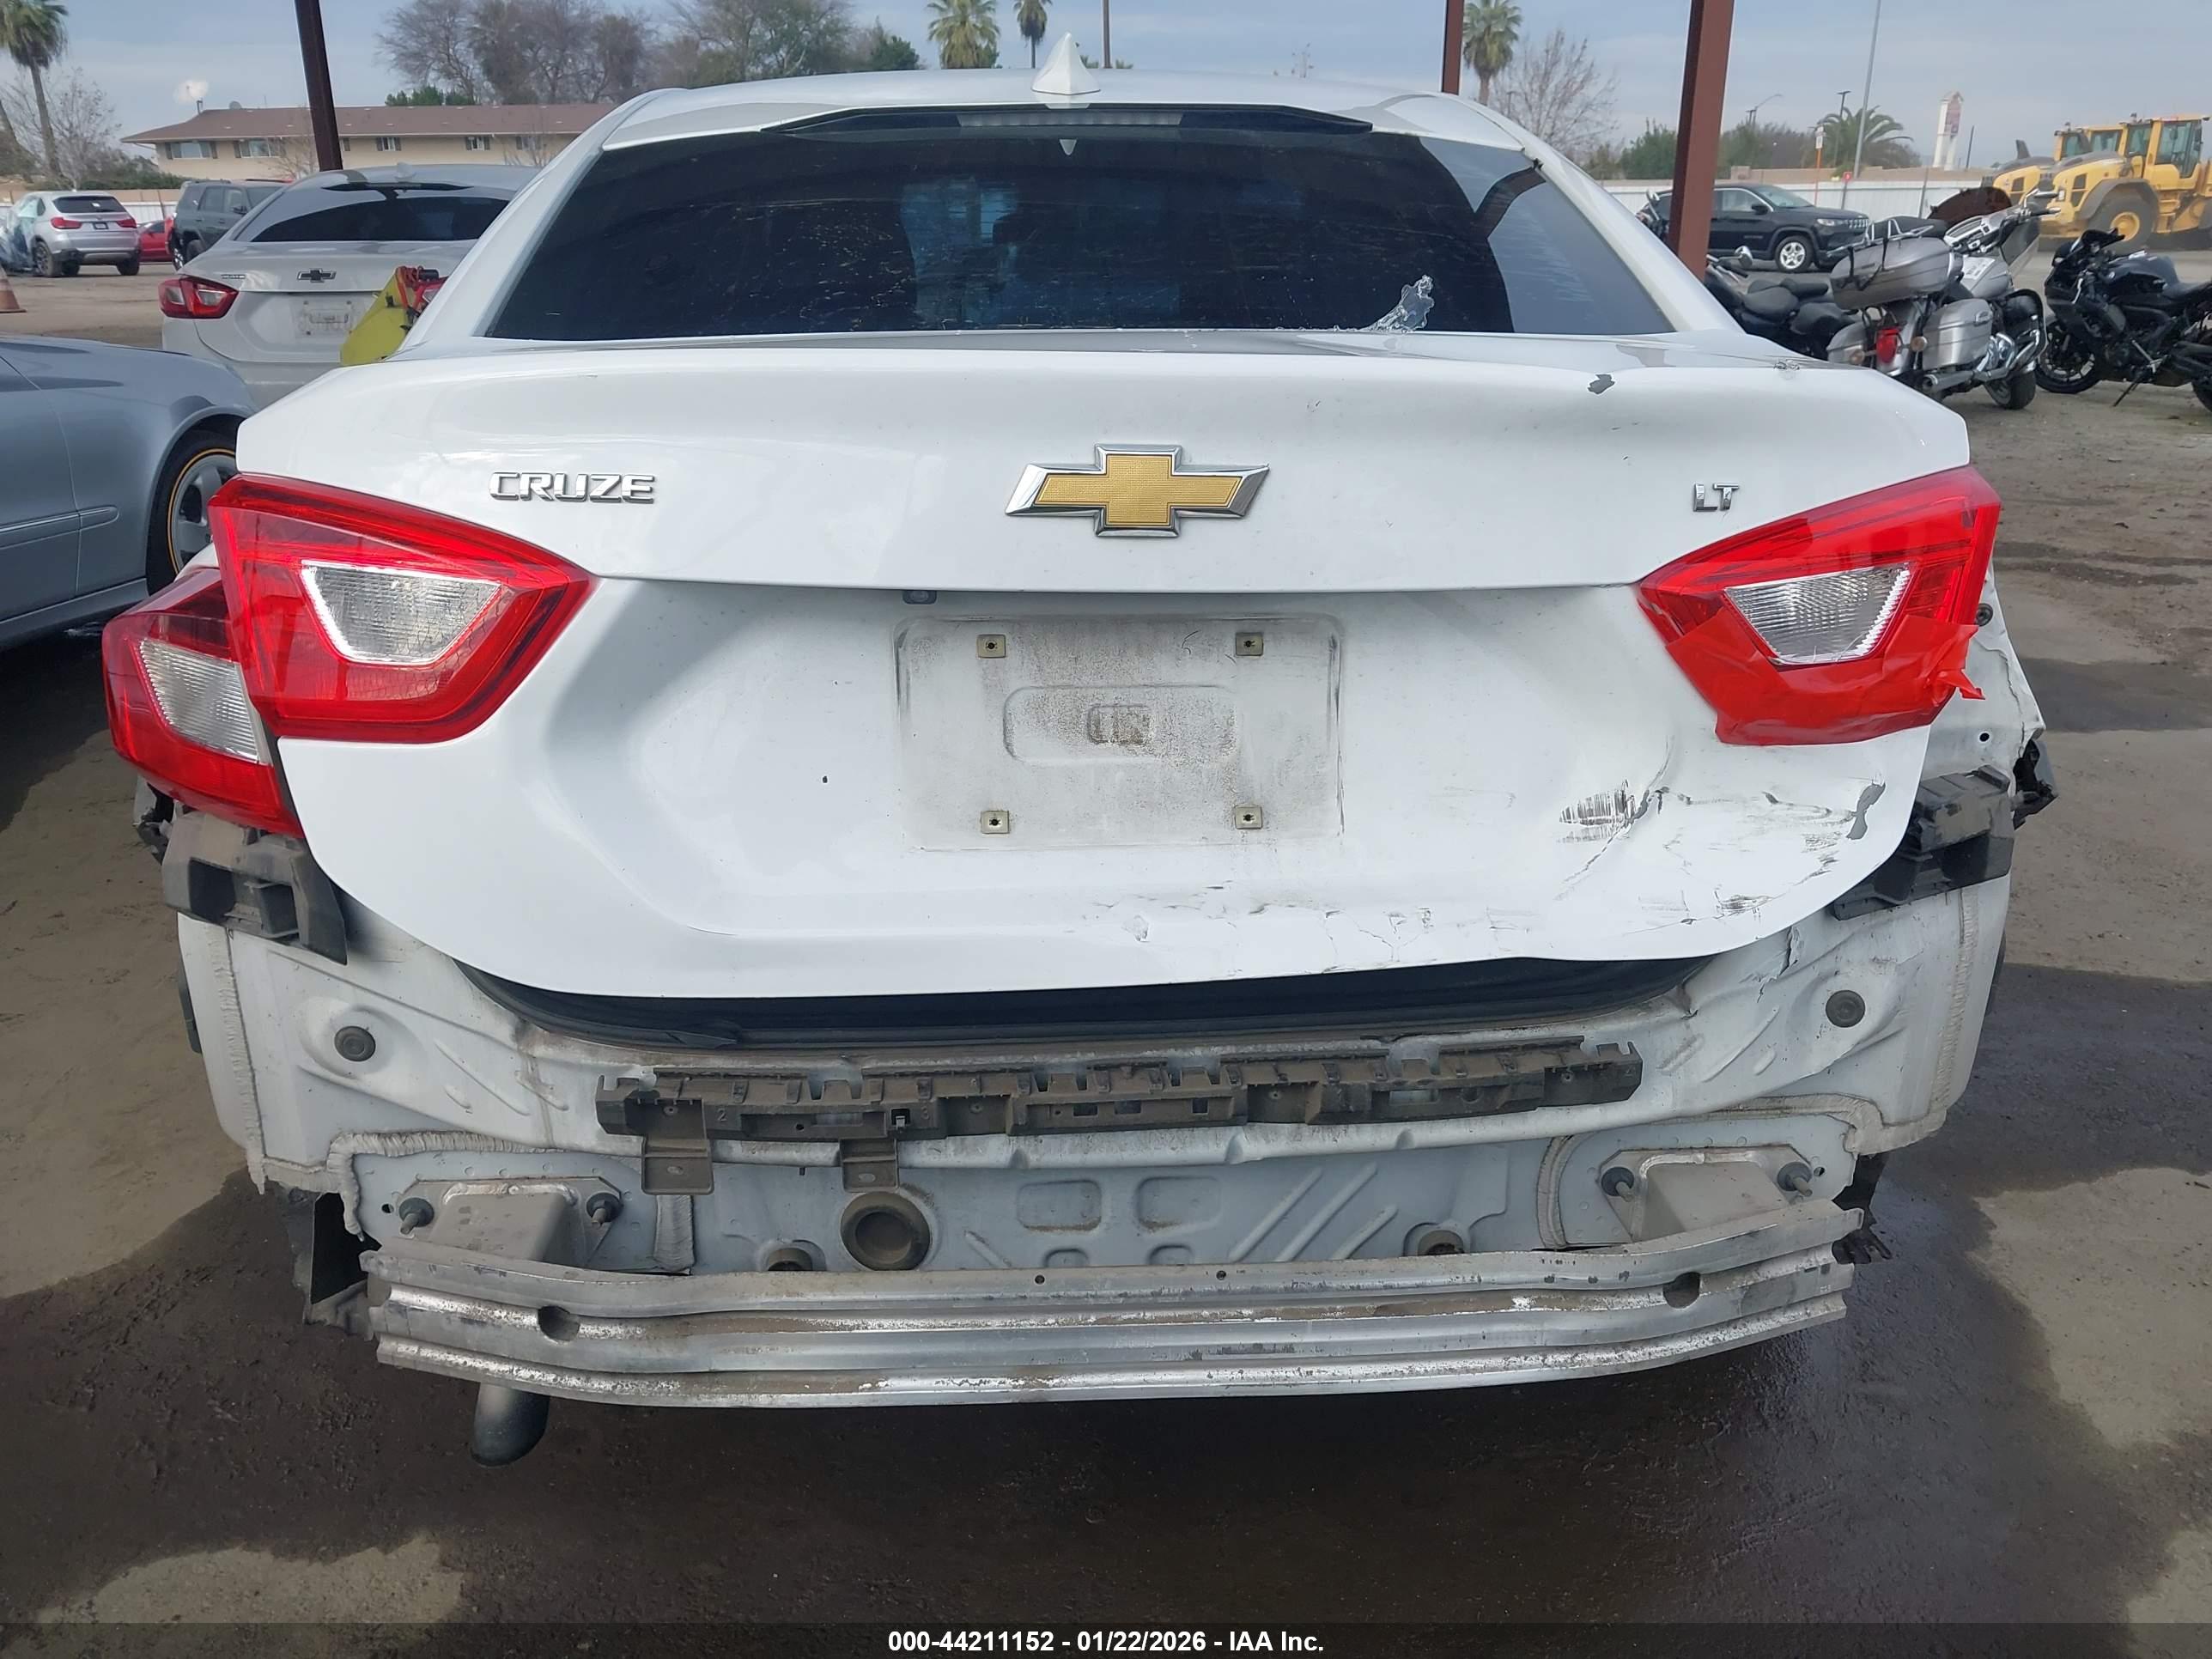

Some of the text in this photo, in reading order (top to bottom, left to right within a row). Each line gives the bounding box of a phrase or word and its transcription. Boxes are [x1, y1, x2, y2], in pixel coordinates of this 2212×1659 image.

[489, 471, 655, 505] CRUZE
[1692, 483, 1740, 512] LT
[716, 1108, 728, 1121] 2
